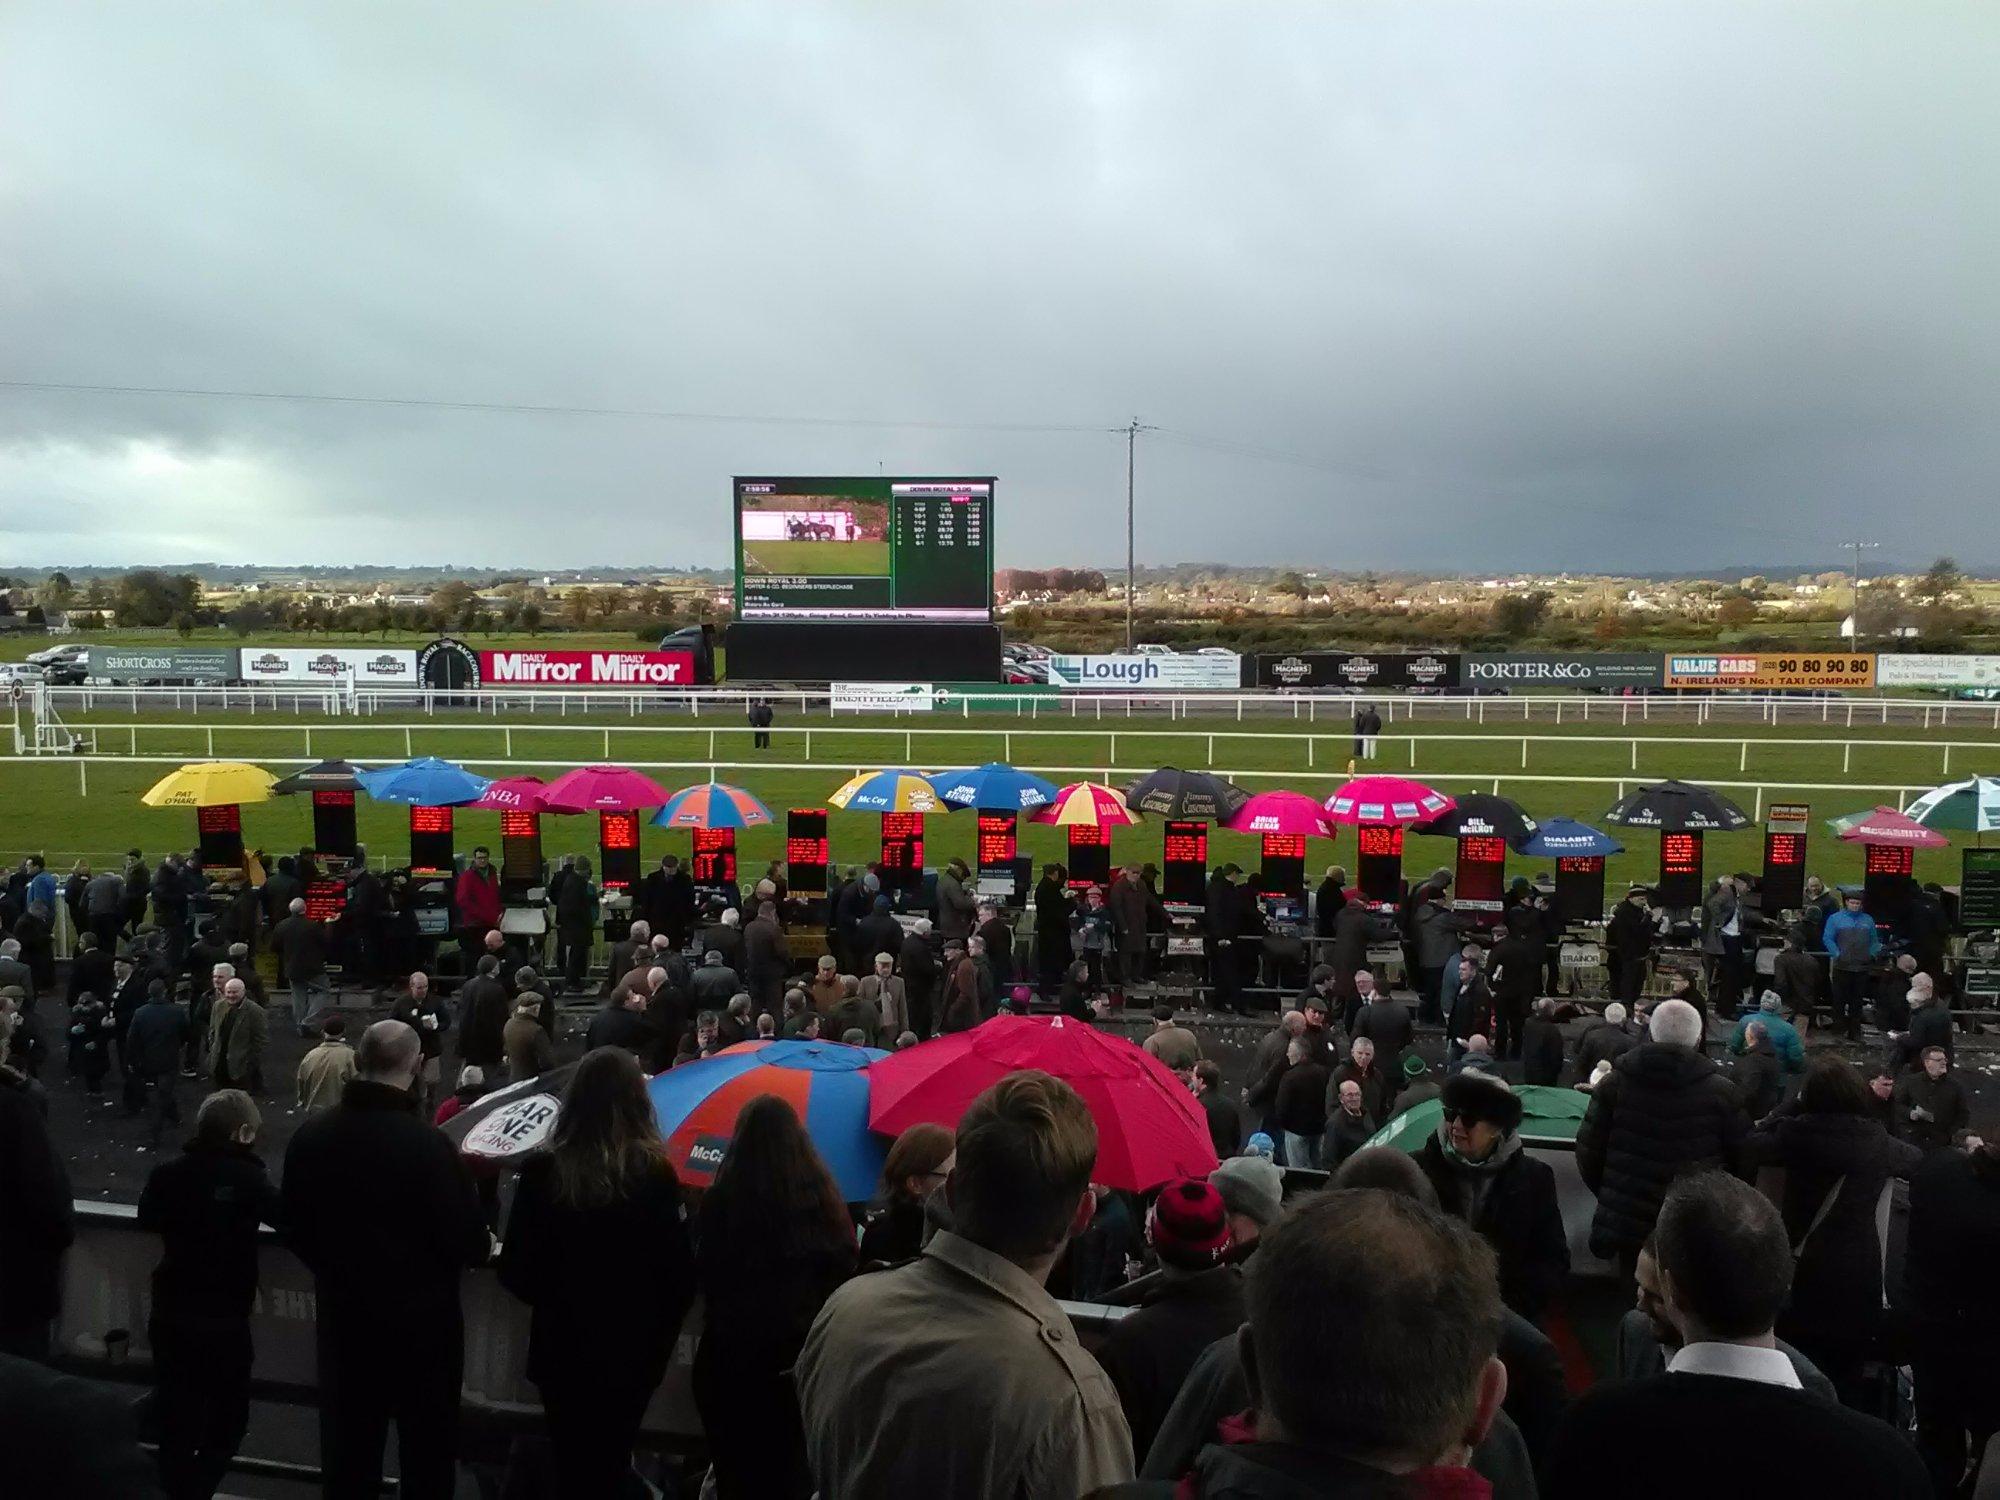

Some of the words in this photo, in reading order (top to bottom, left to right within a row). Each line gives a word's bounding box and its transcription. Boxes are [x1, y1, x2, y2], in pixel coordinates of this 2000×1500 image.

[522, 653, 547, 663] DAILY
[620, 654, 645, 663] DAILY
[254, 662, 288, 671] MAGNERS
[369, 662, 404, 671] MAGNERS
[493, 653, 582, 681] Mirror
[591, 653, 681, 682] Mirror
[1082, 657, 1159, 683] Lough
[1275, 665, 1308, 673] MAGNERS
[1341, 665, 1375, 673] MAGNERS
[1409, 665, 1443, 673] MAGNERS
[1673, 659, 1717, 673] VALUE
[1719, 659, 1756, 673] CABS
[1779, 659, 1797, 673] 90
[1802, 659, 1821, 673] 80
[1826, 659, 1845, 673] 90
[1850, 659, 1869, 673] 80
[1670, 677, 1682, 685] N.
[1686, 677, 1746, 685] IRELAND'S
[1779, 677, 1805, 685] TAXI
[1808, 677, 1868, 685] COMPANY
[955, 784, 977, 795] JOHN
[1148, 788, 1176, 801] Jimmy
[164, 797, 198, 805] O'HARE
[945, 790, 975, 804] STUART
[1184, 791, 1214, 802] Jimmy
[1098, 803, 1122, 816] DAN
[1140, 796, 1172, 814] Casement
[1182, 801, 1216, 815] Casement
[1255, 815, 1279, 823] BRIAN
[1467, 817, 1486, 826] BILL
[1460, 825, 1495, 834] McILROY
[1562, 955, 1600, 964] TRAINOR
